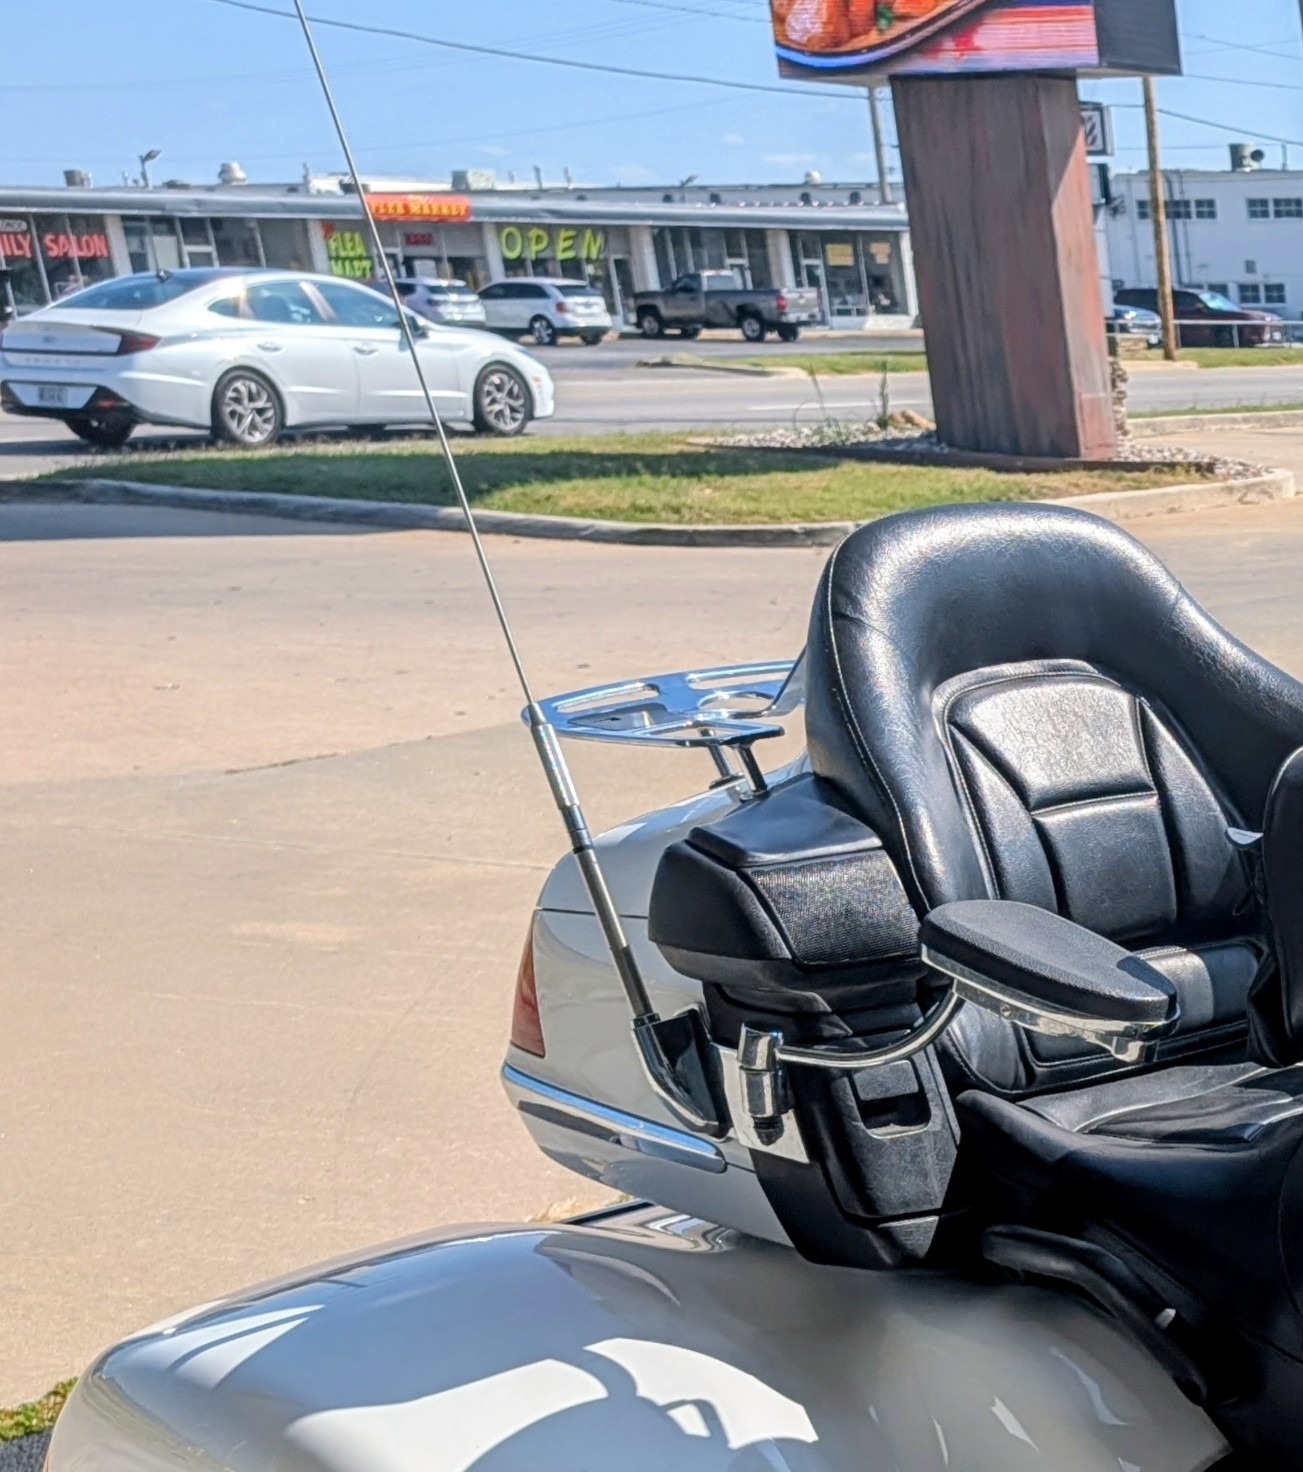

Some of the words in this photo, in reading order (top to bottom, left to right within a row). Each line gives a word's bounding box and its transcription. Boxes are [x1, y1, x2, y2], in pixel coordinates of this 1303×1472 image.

[43, 233, 108, 258] SALON
[329, 232, 367, 258] FLEA
[502, 226, 605, 261] OPEN
[330, 258, 373, 280] MART
